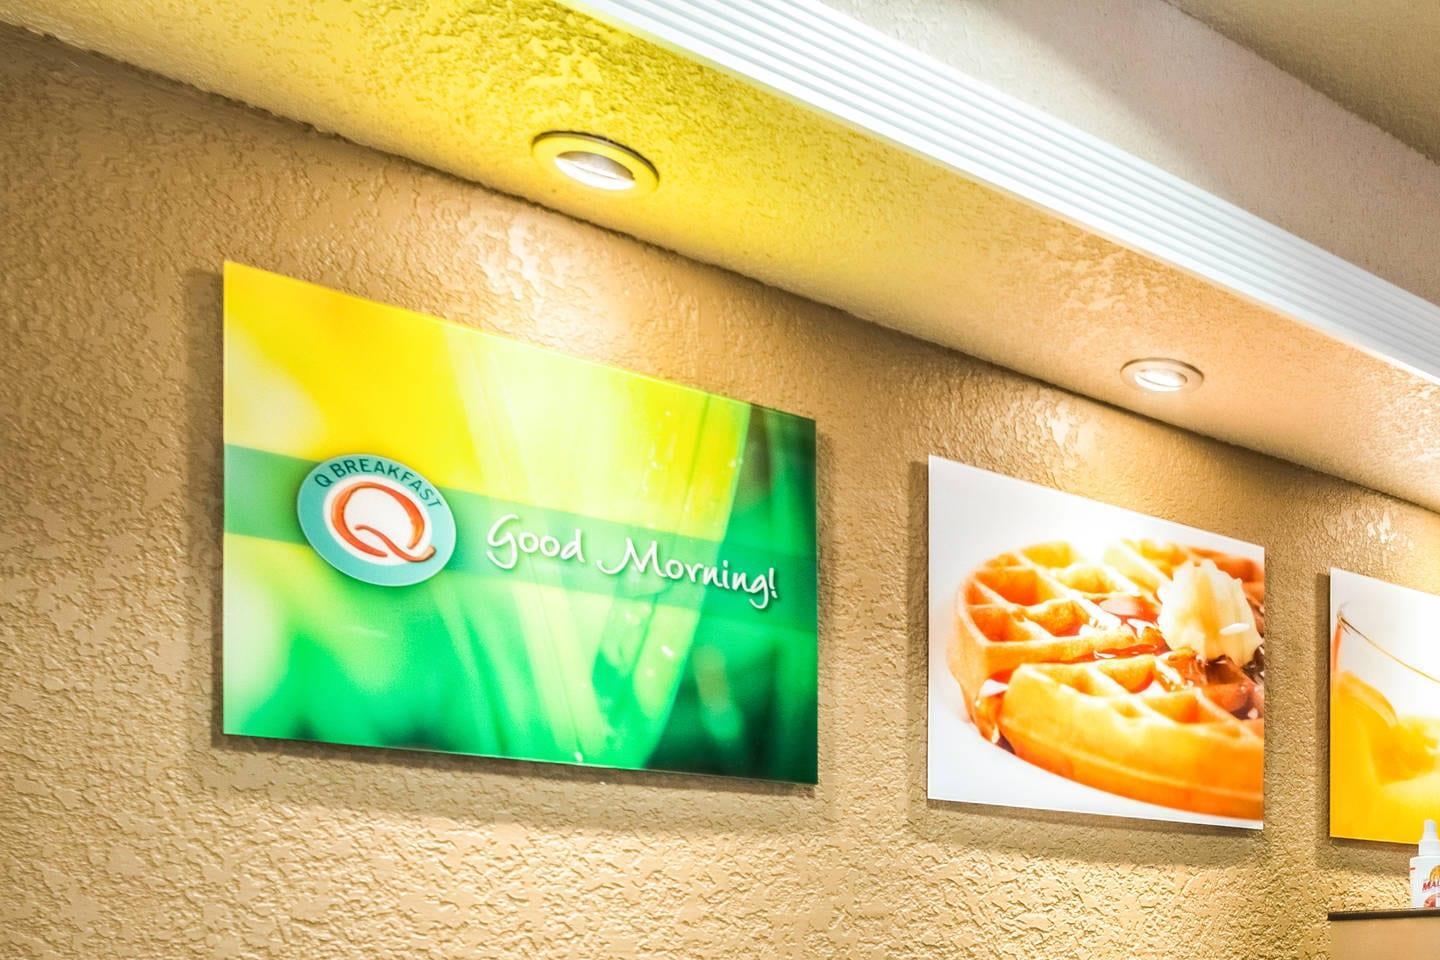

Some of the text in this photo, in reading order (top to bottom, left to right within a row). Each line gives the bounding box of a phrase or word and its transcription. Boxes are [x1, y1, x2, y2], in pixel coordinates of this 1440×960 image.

[313, 458, 442, 508] Q BREAKFAST
[331, 481, 437, 563] Q
[486, 513, 779, 609] Good Morning!
